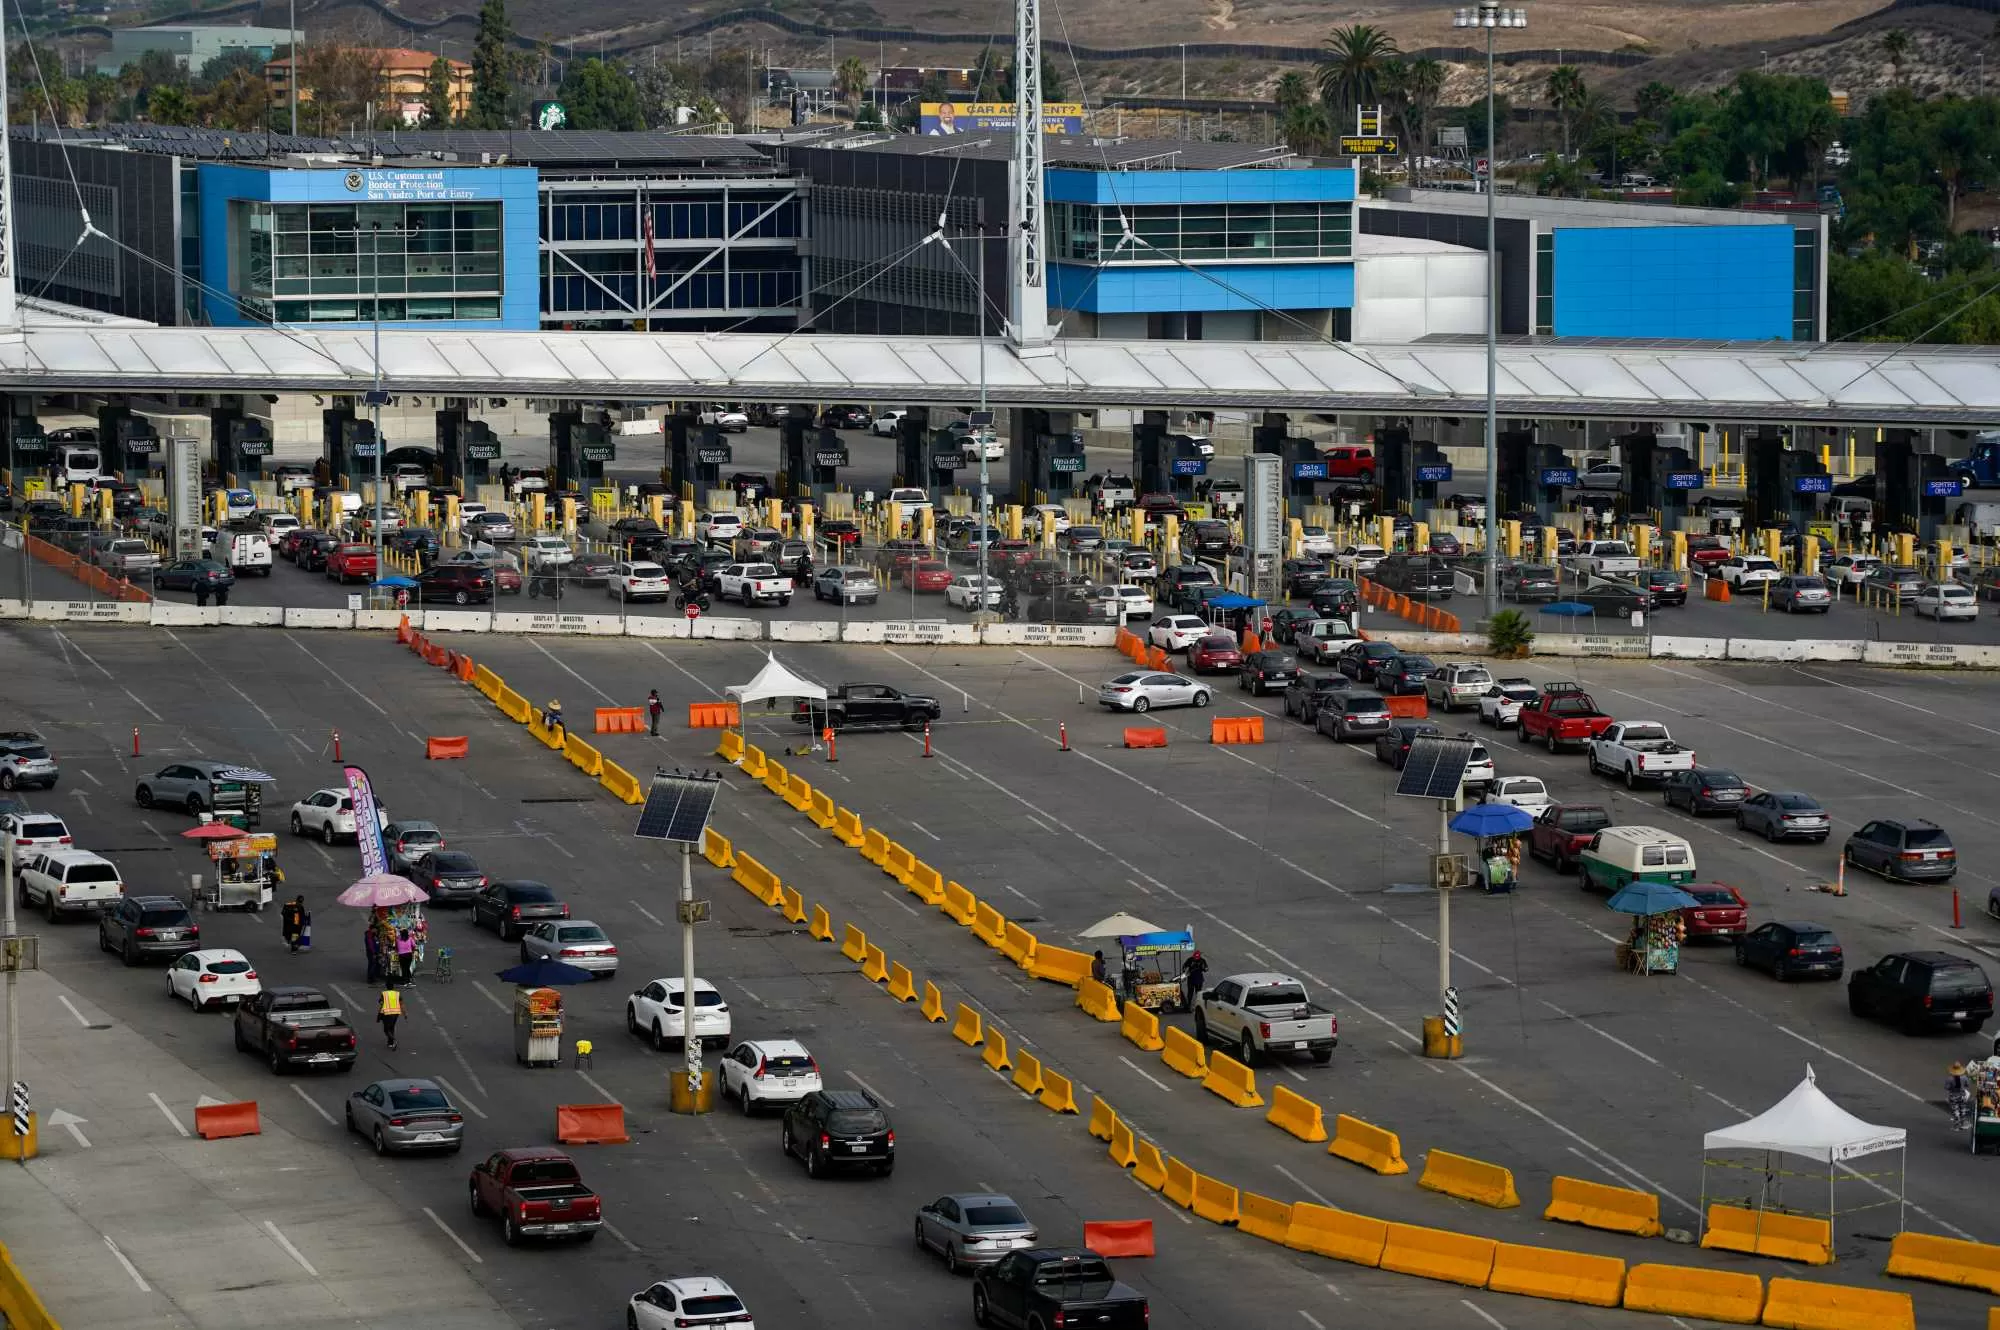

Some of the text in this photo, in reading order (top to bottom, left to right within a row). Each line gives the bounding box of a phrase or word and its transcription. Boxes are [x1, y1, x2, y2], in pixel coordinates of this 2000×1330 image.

[966, 105, 1077, 115] CAR ACENT?
[1349, 145, 1377, 153] PARKING
[368, 171, 443, 180] U.S. Customs and
[368, 180, 444, 189] Border Protection
[367, 190, 384, 199] San
[416, 190, 434, 199] Port
[437, 190, 447, 199] of
[449, 190, 475, 200] Entry
[1421, 466, 1447, 474] SENTRI
[1425, 472, 1443, 480] ONLY
[1934, 487, 1952, 495] ONLY
